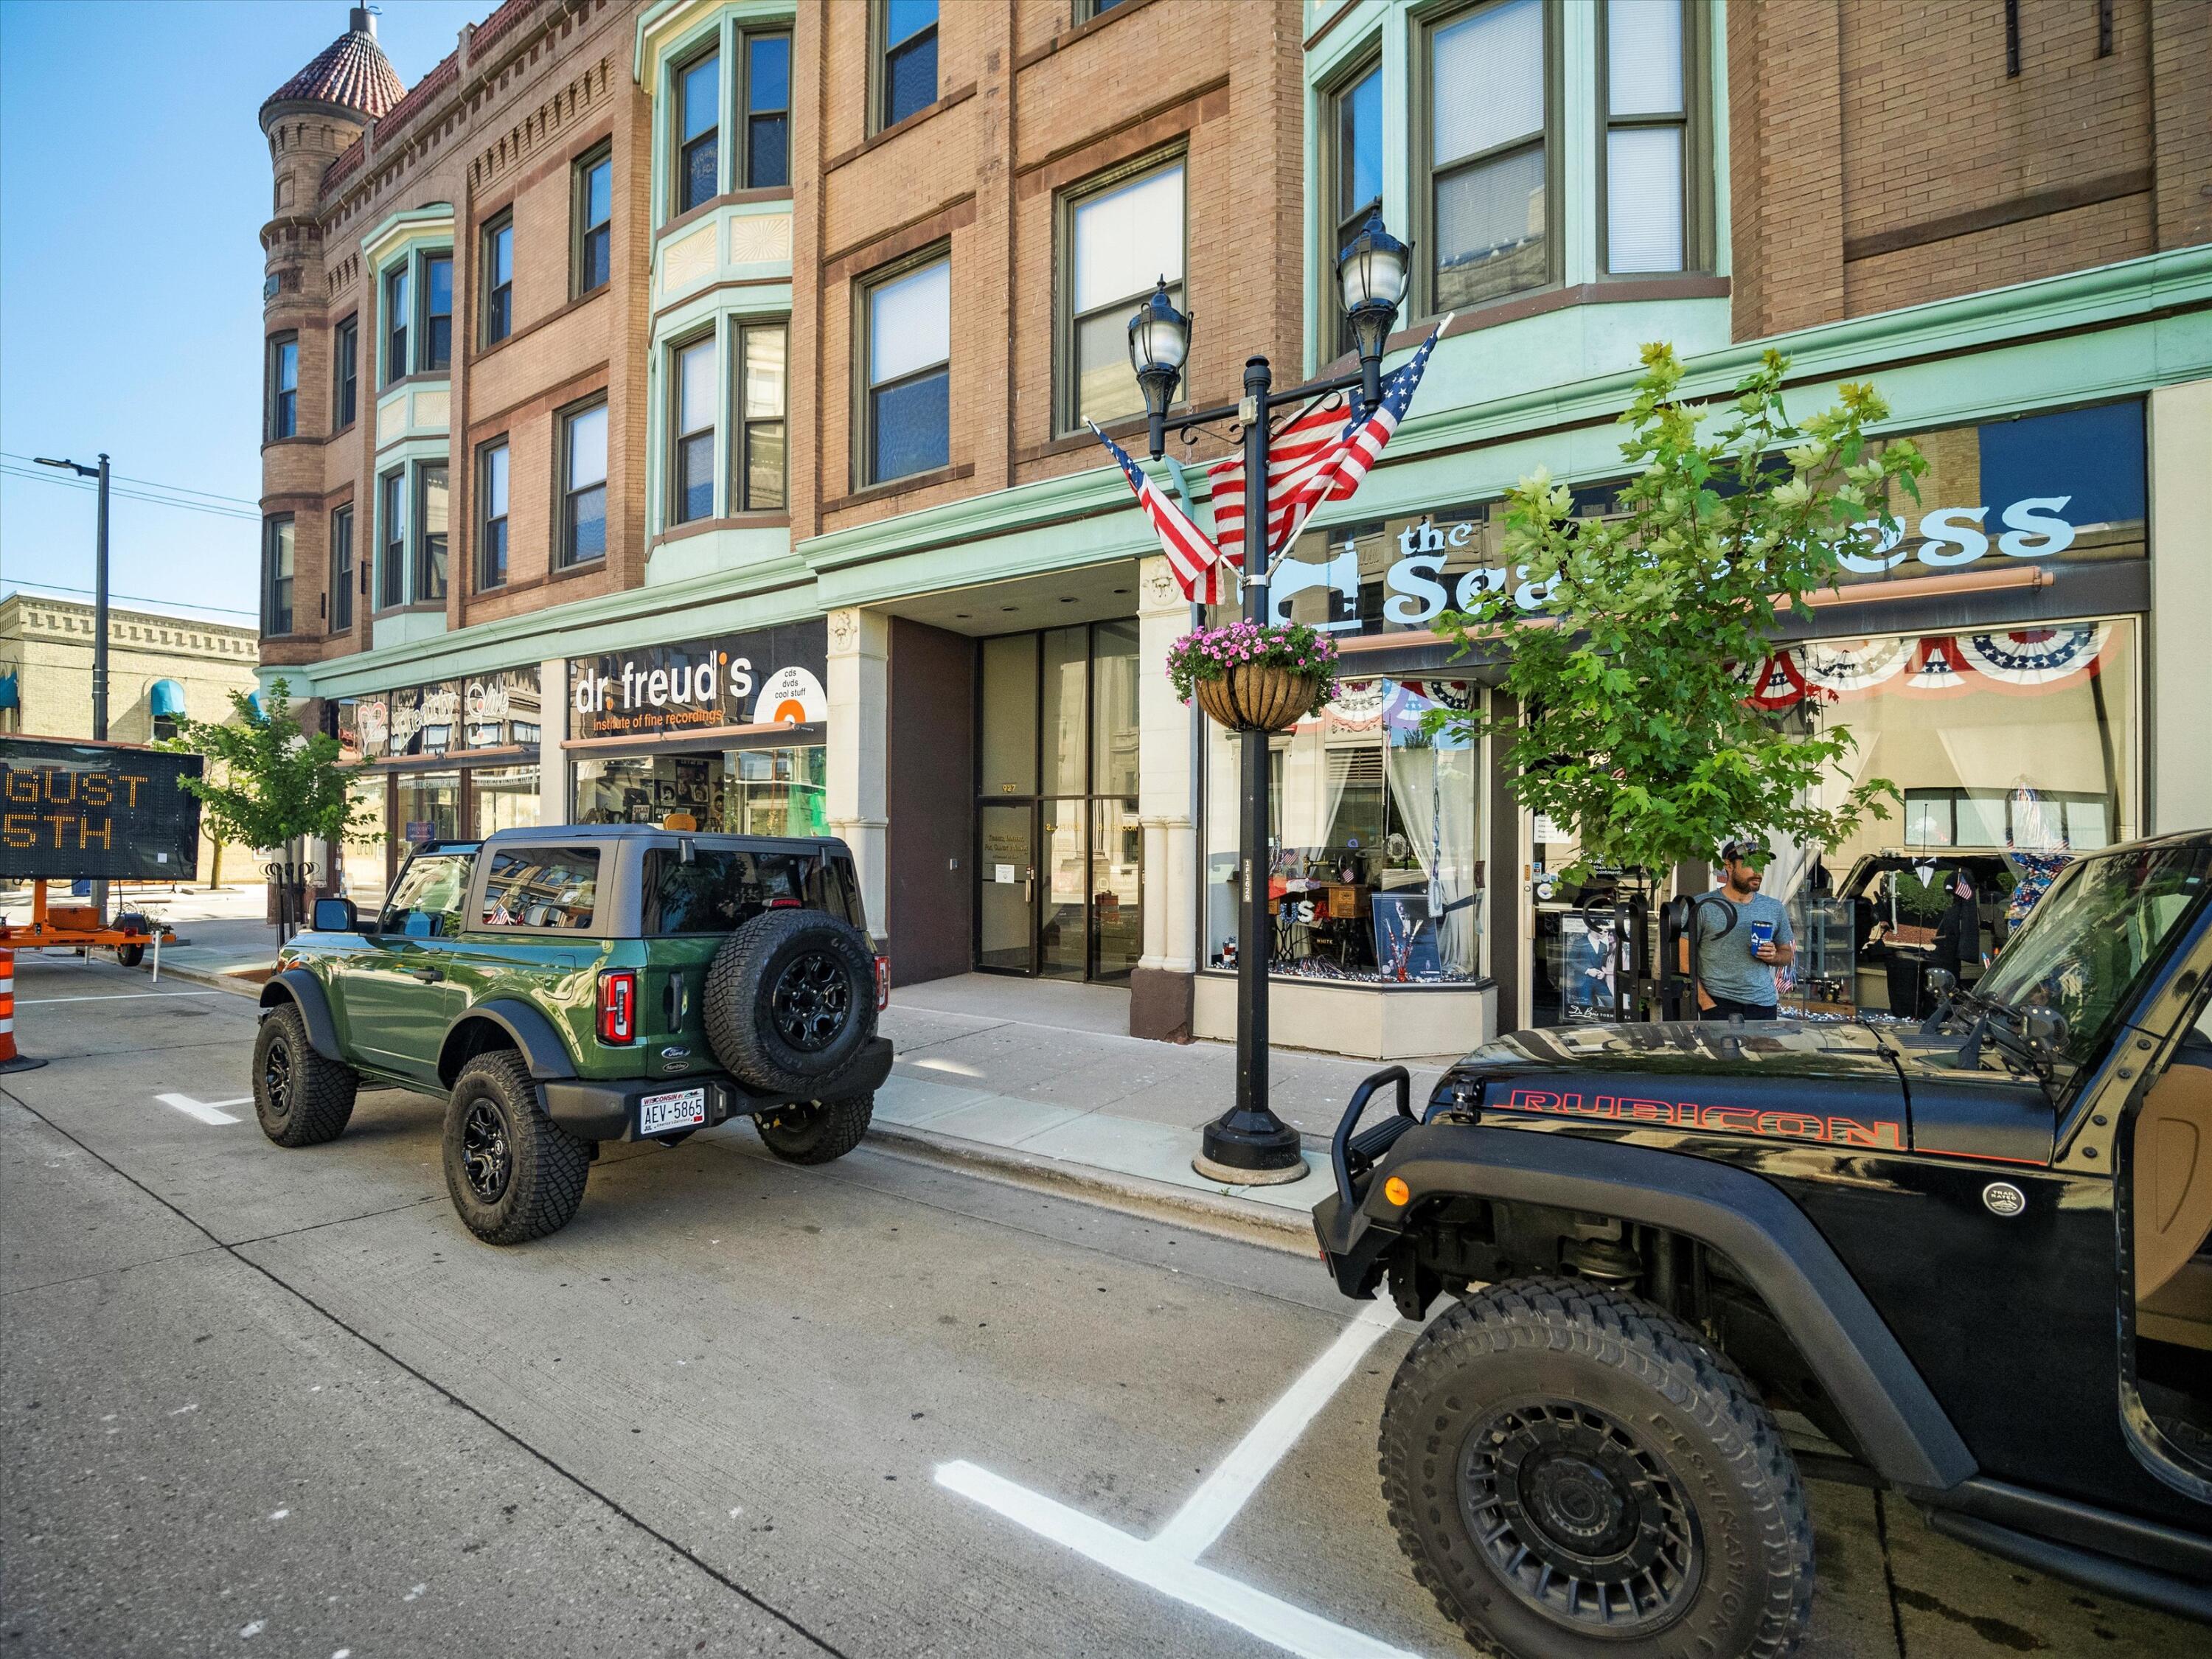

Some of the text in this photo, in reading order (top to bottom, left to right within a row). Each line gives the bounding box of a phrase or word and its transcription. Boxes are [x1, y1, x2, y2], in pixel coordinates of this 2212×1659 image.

[1397, 521, 1472, 555] the
[1382, 495, 2076, 625] Seaess
[782, 679, 799, 687] dvds
[785, 669, 796, 677] cds
[576, 668, 613, 714] dr.
[775, 687, 806, 698] cool stuff
[392, 689, 456, 750] Hearty
[594, 708, 723, 731] institute of fine recordings
[4, 814, 111, 849] 5TH
[1280, 900, 1331, 925] USA
[668, 1048, 684, 1057] Ford
[644, 1093, 677, 1105] WISCONSIN
[644, 1099, 702, 1125] AEV-5865
[1495, 1090, 1908, 1151] RUBICON
